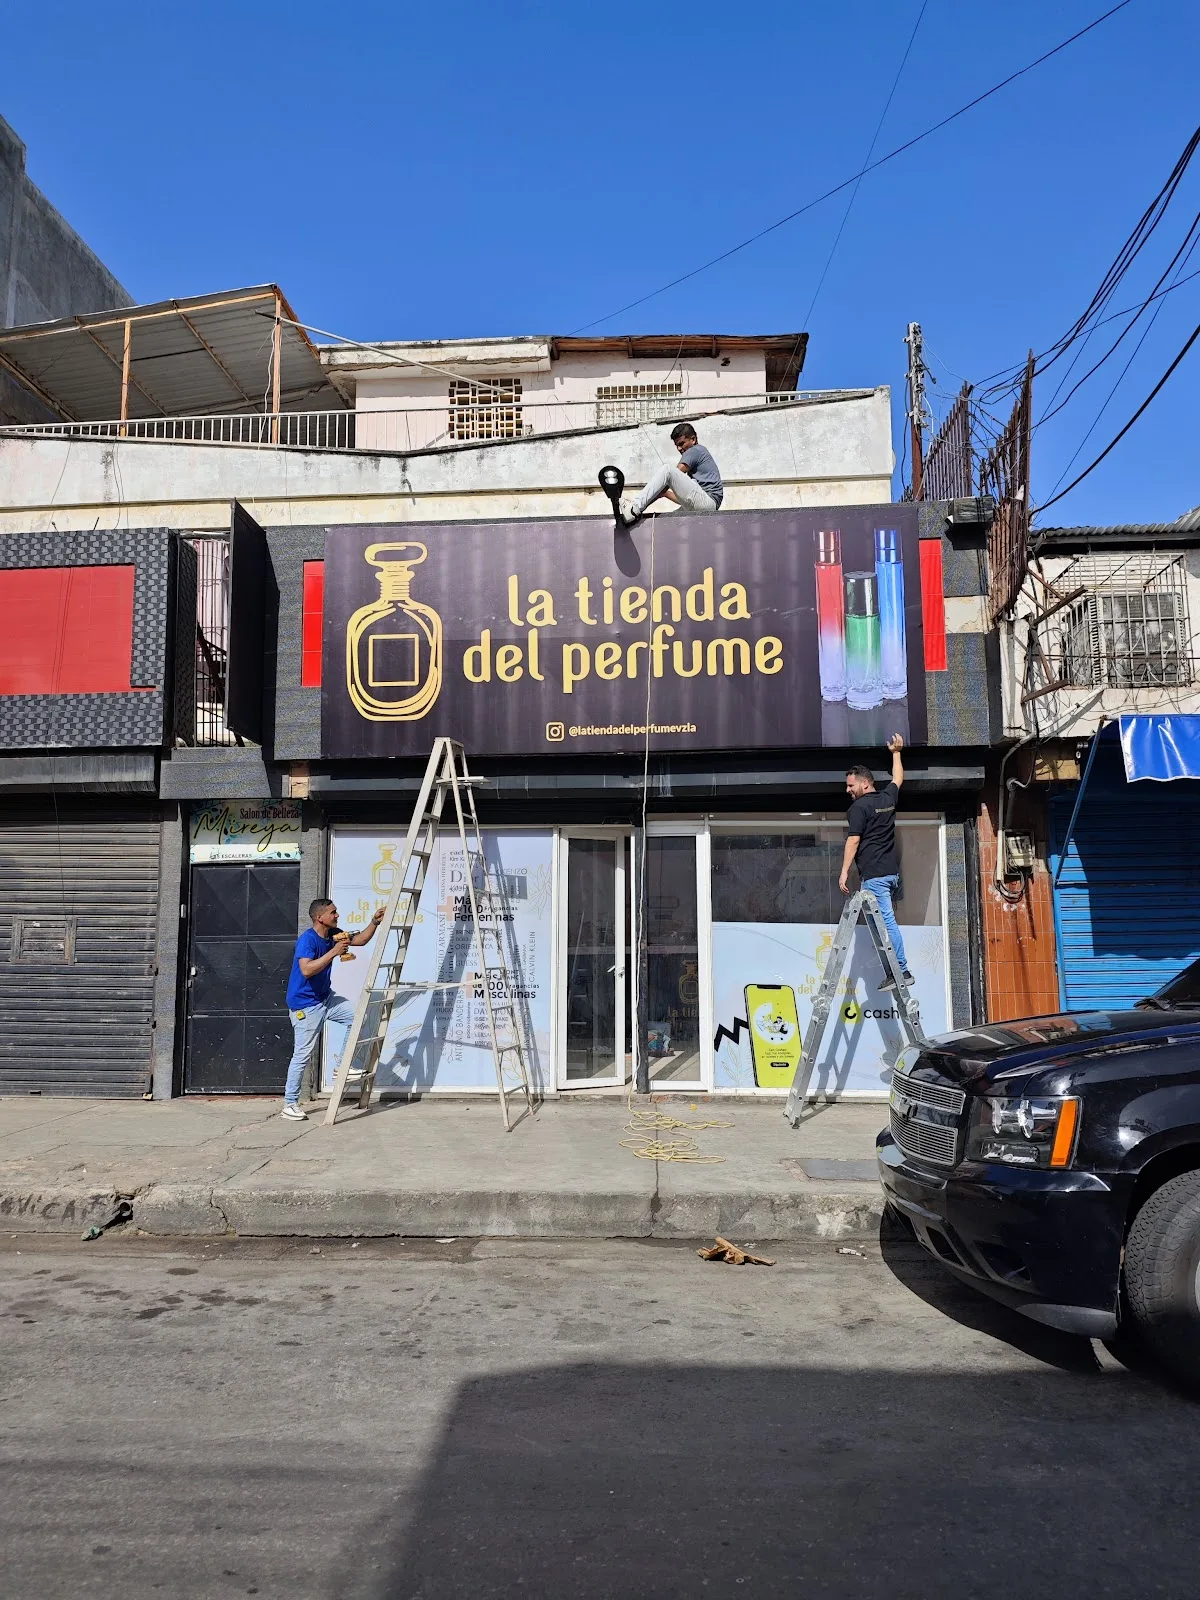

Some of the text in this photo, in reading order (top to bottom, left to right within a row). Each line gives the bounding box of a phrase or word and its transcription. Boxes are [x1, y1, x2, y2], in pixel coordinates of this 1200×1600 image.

[508, 566, 751, 627] la tienda
[463, 624, 784, 694] del perfume
[568, 722, 697, 737] @latiendadelperfumevzla
[240, 807, 299, 819] Salon de Belleza
[193, 807, 300, 853] Mireya
[358, 897, 369, 911] la
[347, 911, 367, 923] del
[805, 973, 816, 985] la
